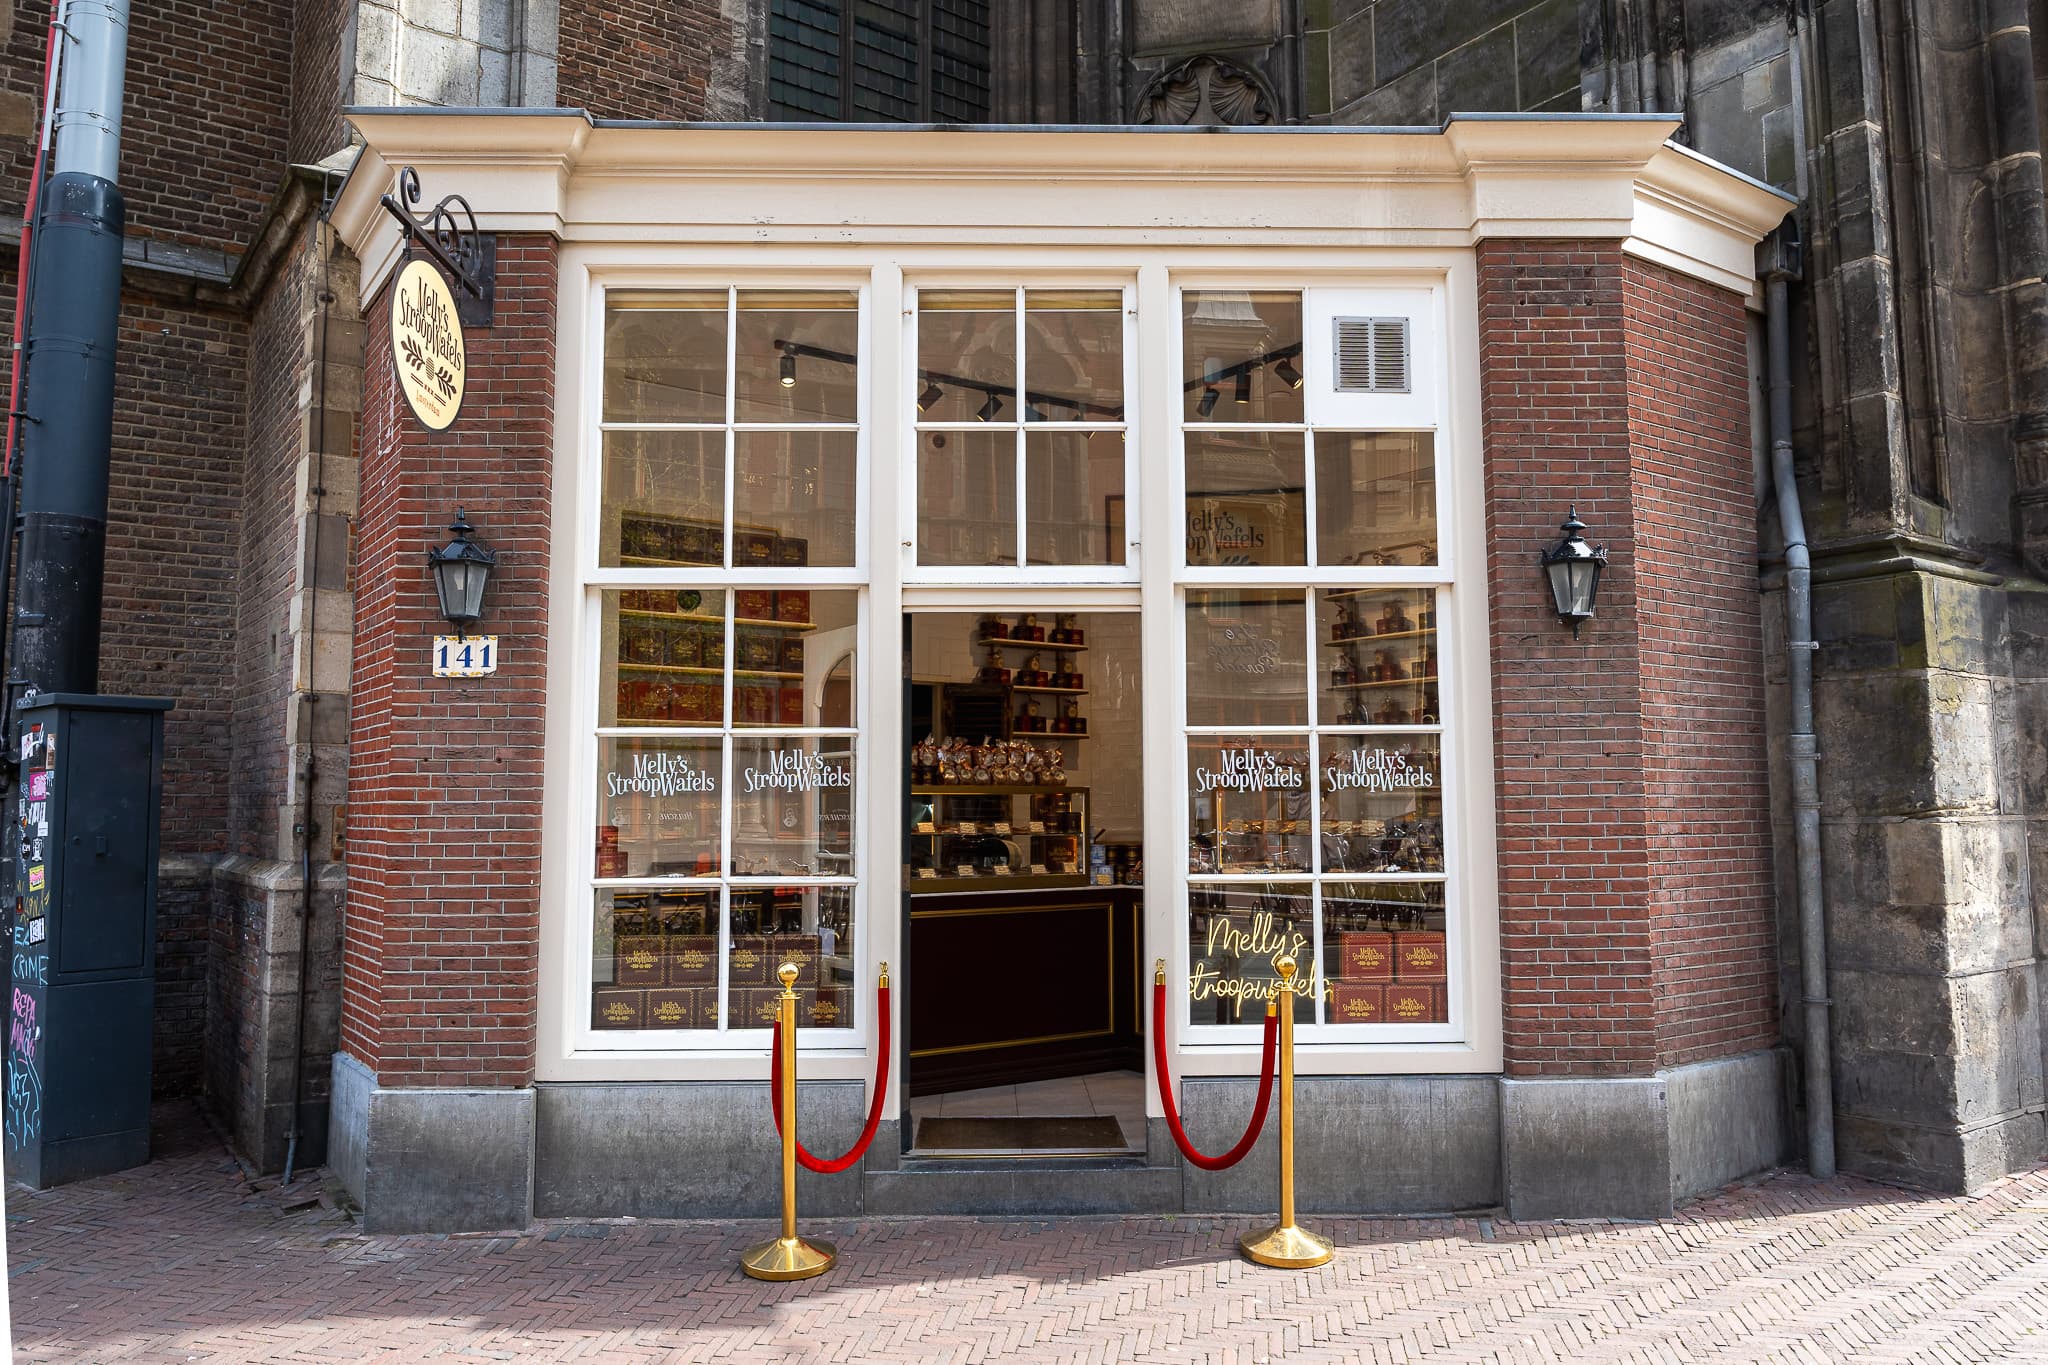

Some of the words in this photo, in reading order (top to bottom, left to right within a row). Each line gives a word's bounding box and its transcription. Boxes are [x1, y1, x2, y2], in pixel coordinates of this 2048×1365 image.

[417, 275, 449, 333] Melly's
[399, 288, 462, 371] StroopWafels
[437, 644, 492, 669] 141
[632, 752, 689, 779] Melly's
[769, 748, 825, 775] Melly's
[1220, 748, 1276, 775] Melly's
[1351, 748, 1407, 775] Melly's
[606, 769, 716, 798] StroopWafels
[743, 765, 852, 793] StroopWafels
[1195, 766, 1303, 793] StroopWafels
[1327, 765, 1434, 793] StroopWafels
[1207, 912, 1308, 967] Melly's
